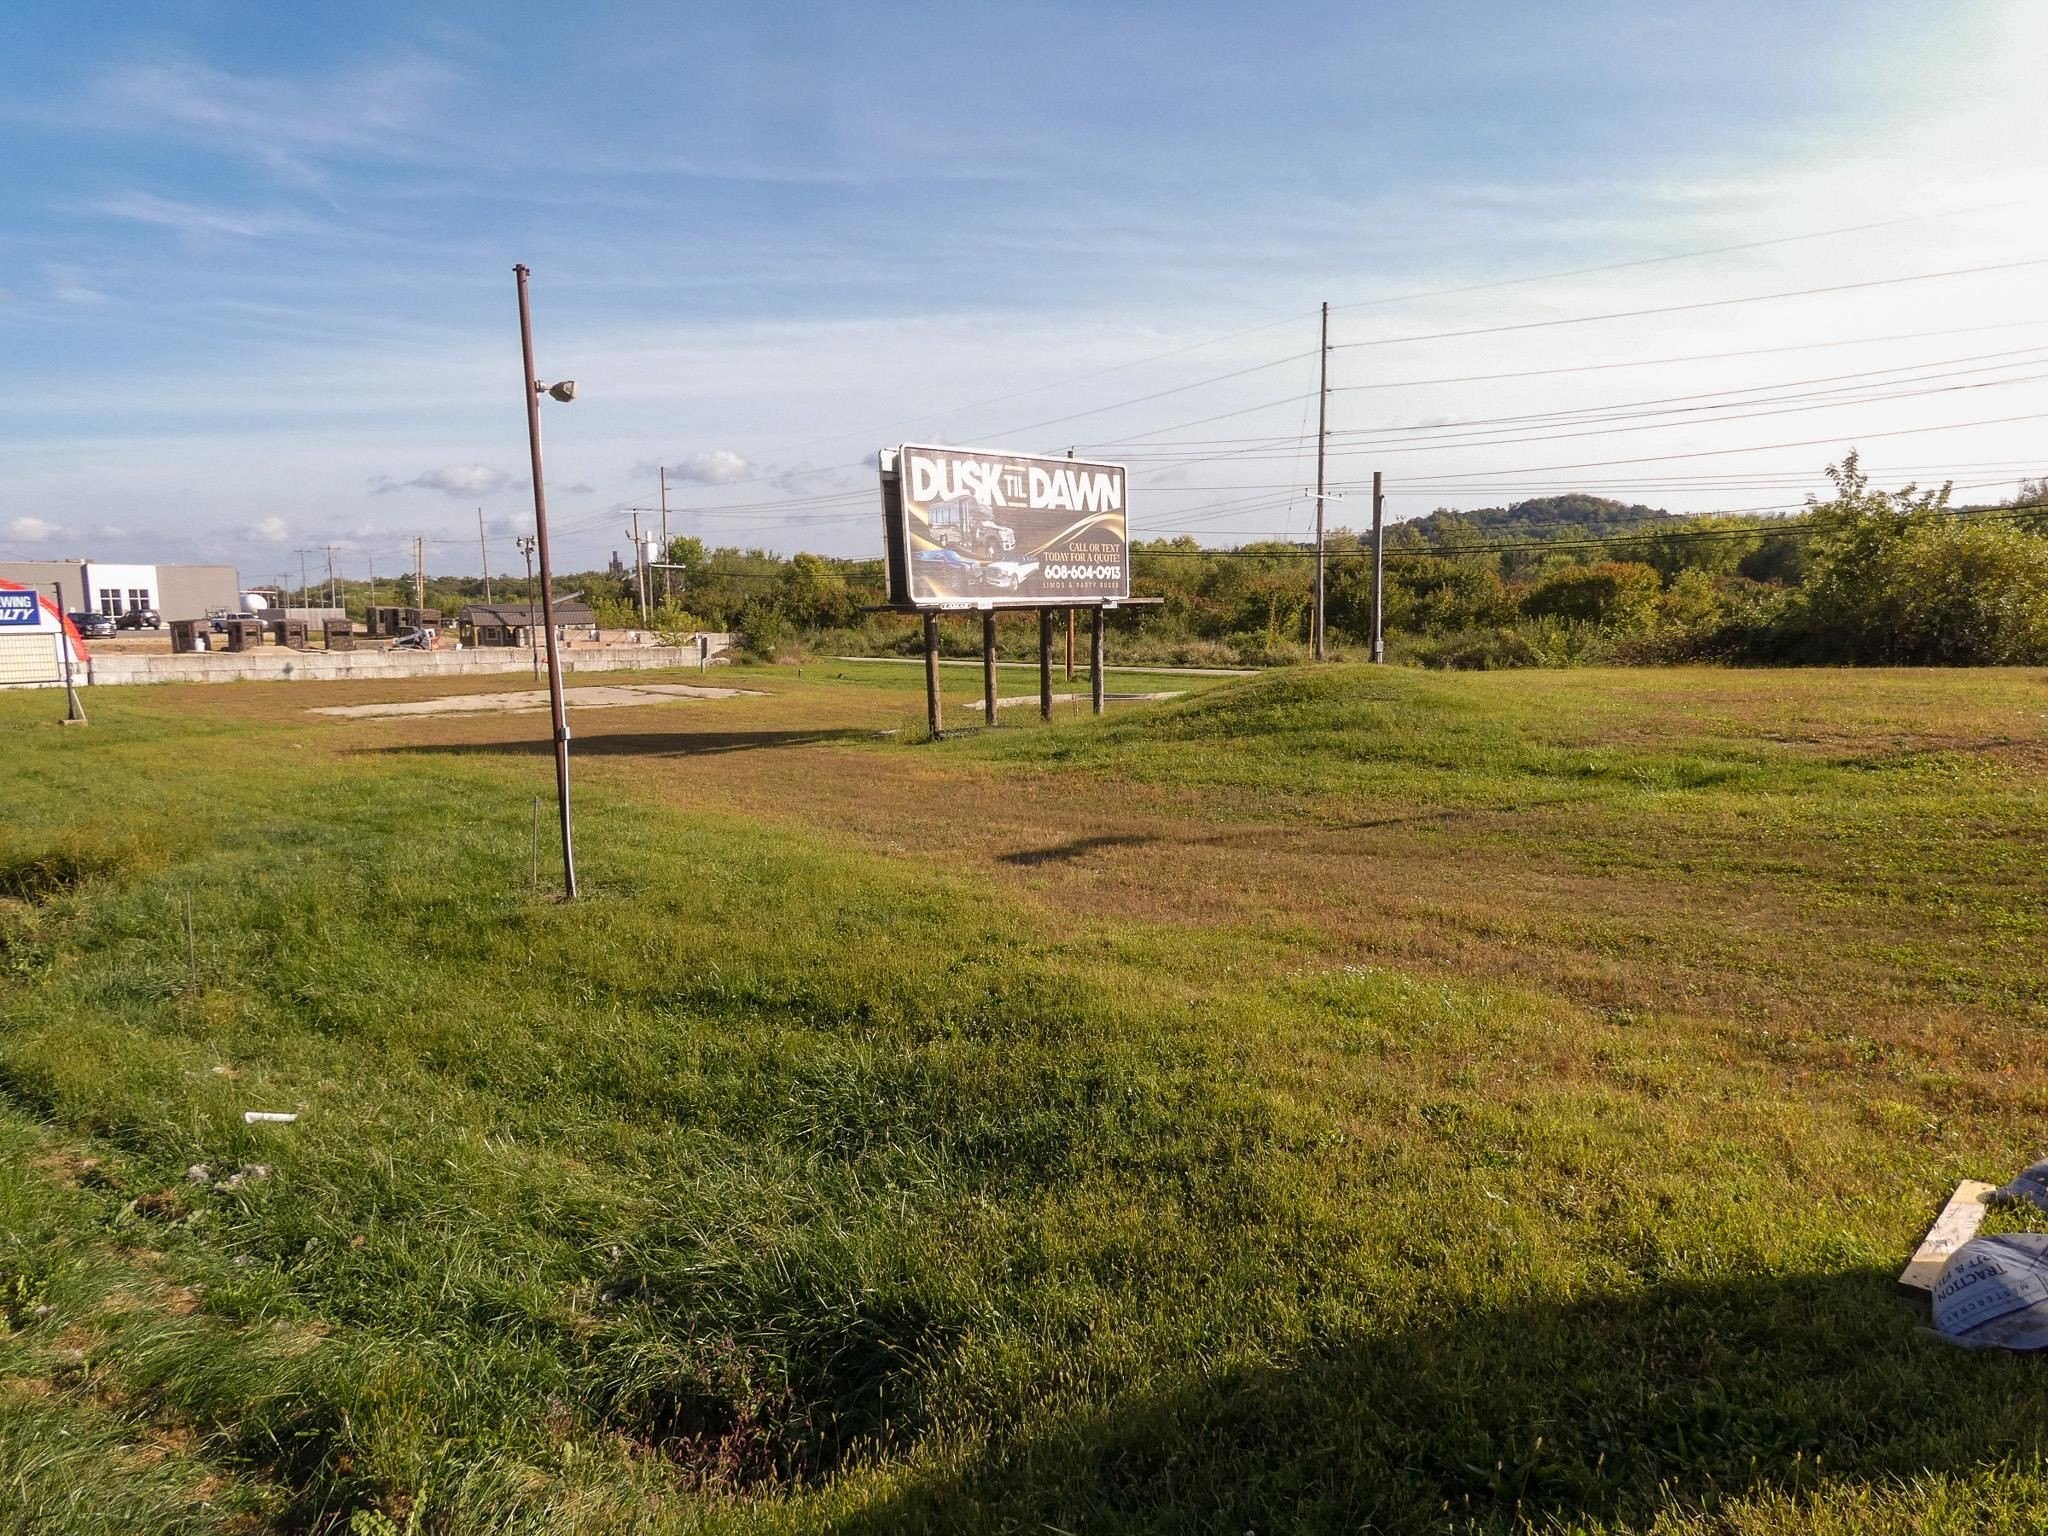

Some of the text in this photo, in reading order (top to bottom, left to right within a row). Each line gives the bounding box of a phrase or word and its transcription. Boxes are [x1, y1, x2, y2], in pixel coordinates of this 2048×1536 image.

[911, 456, 1008, 507] DUSK
[1029, 467, 1121, 512] DAWN
[1069, 543, 1120, 553] CALL OR TEXT
[1043, 552, 1120, 564] TODAY FOR A QUOTE!
[1044, 564, 1121, 580] 608-604-0913
[0, 596, 31, 608] WING
[1938, 1263, 2008, 1302] TRACTION
